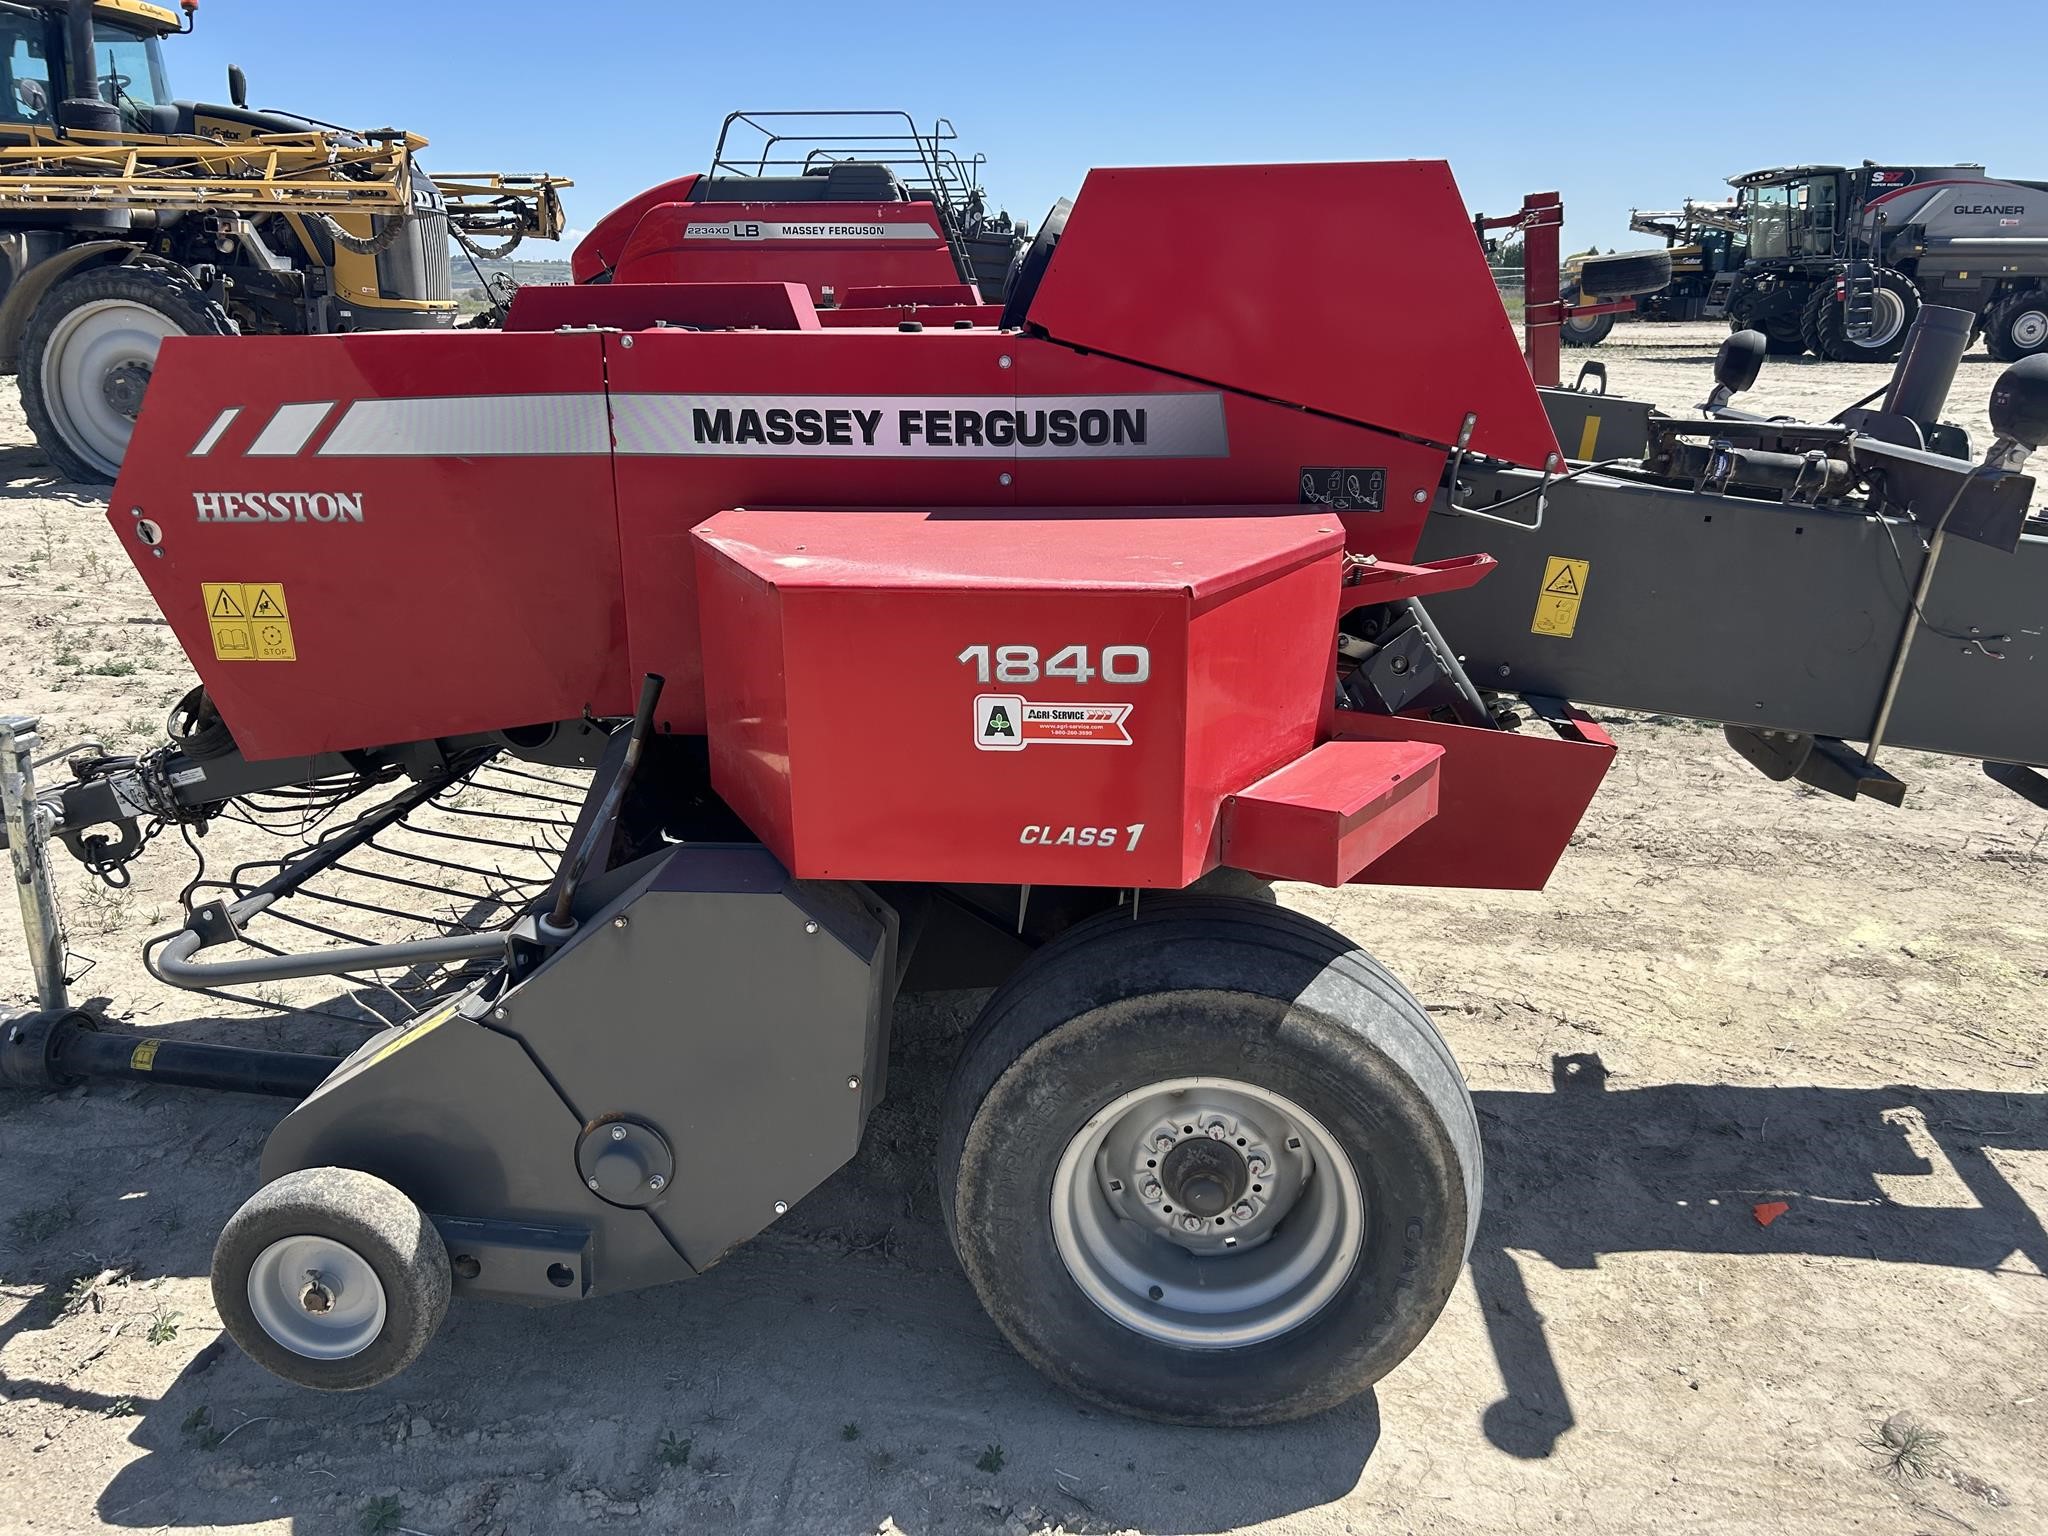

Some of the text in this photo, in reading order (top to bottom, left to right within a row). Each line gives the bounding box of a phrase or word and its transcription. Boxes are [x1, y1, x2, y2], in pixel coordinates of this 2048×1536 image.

[1954, 205, 2025, 215] GLEANER
[733, 224, 760, 237] LB
[782, 226, 885, 235] MASSEY FERGUSON
[692, 408, 1148, 446] MASSEY FERGUSON
[192, 491, 364, 523] HESSTON
[263, 648, 287, 656] STOP
[957, 644, 1150, 684] 1840
[1019, 823, 1145, 852] CLASS 1
